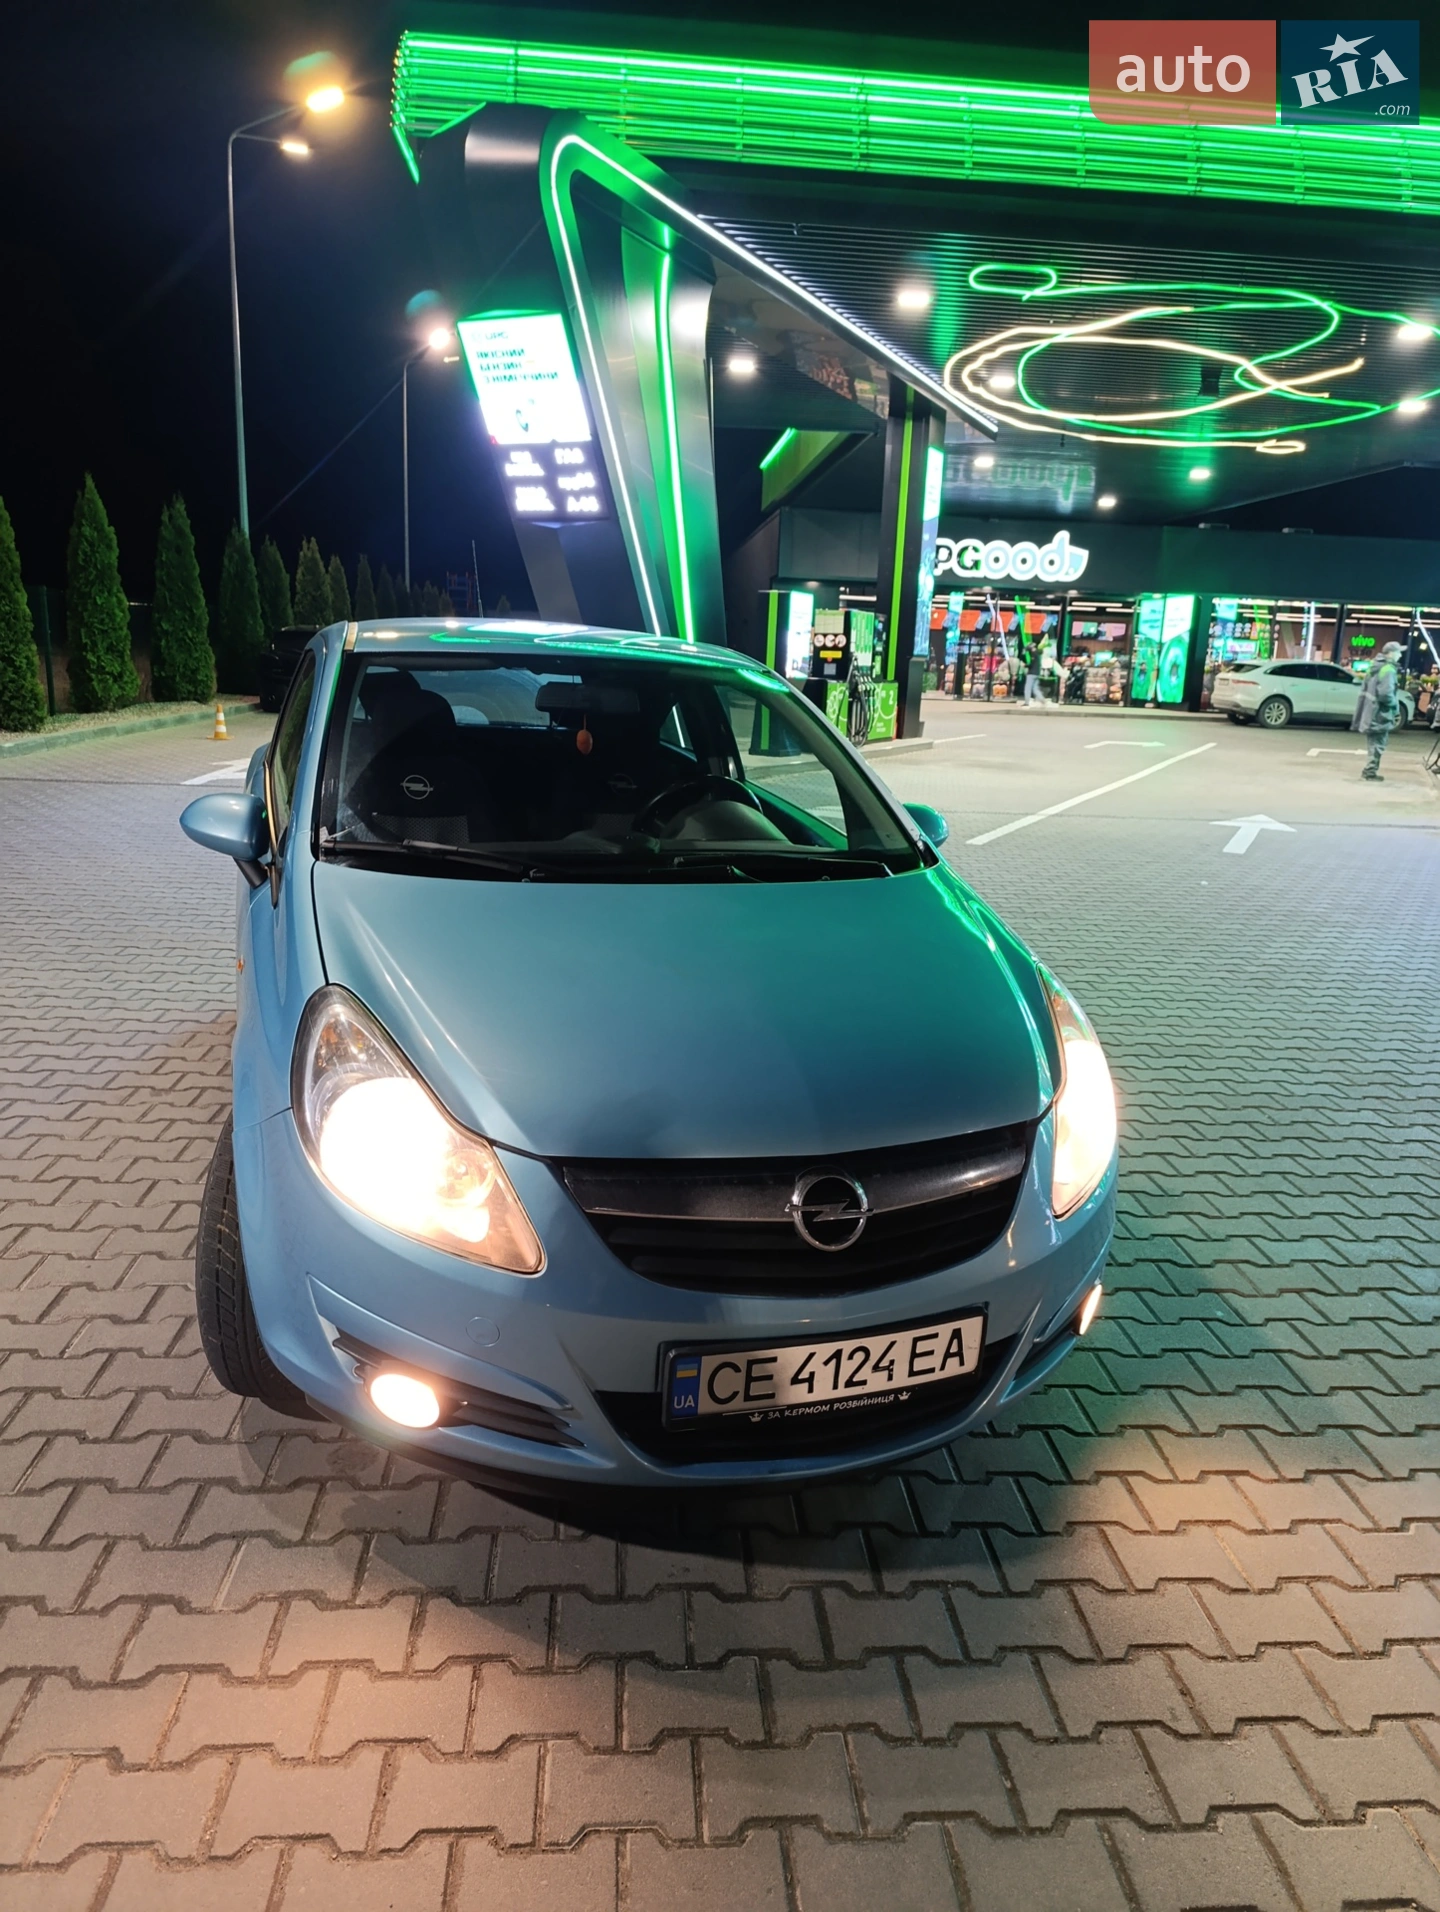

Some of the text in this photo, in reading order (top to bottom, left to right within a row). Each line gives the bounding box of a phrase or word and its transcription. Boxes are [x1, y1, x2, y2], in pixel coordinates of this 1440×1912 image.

[673, 1327, 966, 1409] UA CE 4124 EA
[767, 1411, 781, 1420] ЗА
[784, 1404, 830, 1417] КЕРМОМ
